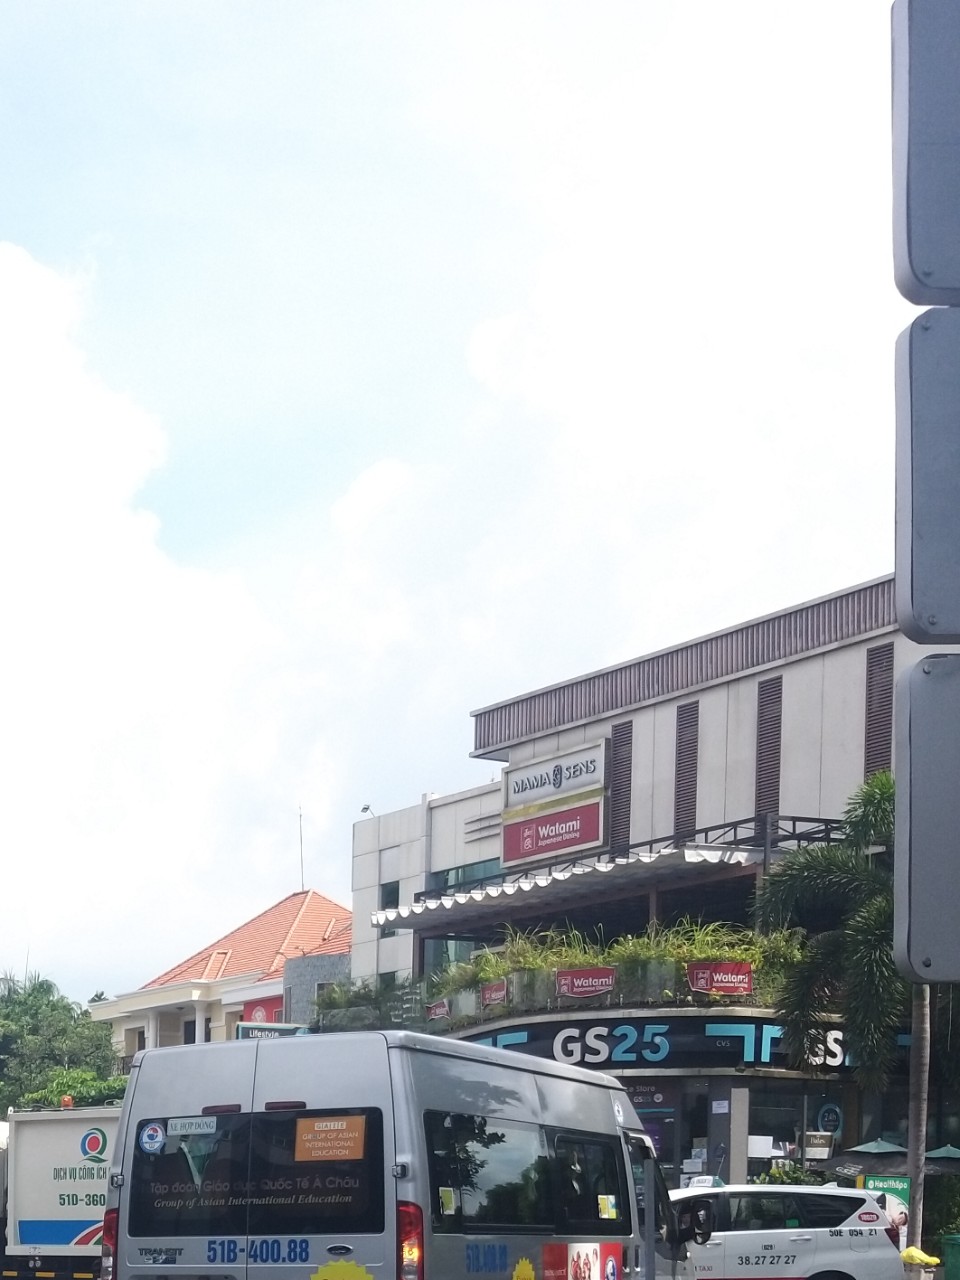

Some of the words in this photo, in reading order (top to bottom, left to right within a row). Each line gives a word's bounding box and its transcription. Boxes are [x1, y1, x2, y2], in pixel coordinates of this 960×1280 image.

[513, 772, 551, 794] MAMA
[565, 759, 596, 780] SENS
[538, 816, 580, 839] Watami
[573, 976, 612, 987] Watami
[712, 972, 748, 983] Watami
[552, 1024, 670, 1065] GS25
[824, 1112, 837, 1121] 24h
[338, 1131, 359, 1139] ASIAN
[306, 1140, 354, 1149] INTERNATIONAL
[312, 1149, 349, 1157] EDUCATION
[53, 1167, 67, 1182] DỊCH
[69, 1167, 77, 1182] VỤ
[78, 1165, 95, 1180] CÔNG
[96, 1165, 107, 1180] ÍCH
[59, 1193, 106, 1206] 51D-360
[154, 1199, 184, 1209] Group
[186, 1197, 197, 1208] of
[197, 1198, 225, 1206] Asian
[228, 1195, 295, 1206] International
[298, 1193, 352, 1204] Education
[138, 1248, 184, 1256] TRANSIT
[207, 1239, 309, 1263] 51B-400.88
[737, 1255, 767, 1265] 38.27
[769, 1255, 782, 1265] 27
[784, 1255, 797, 1265] 27
